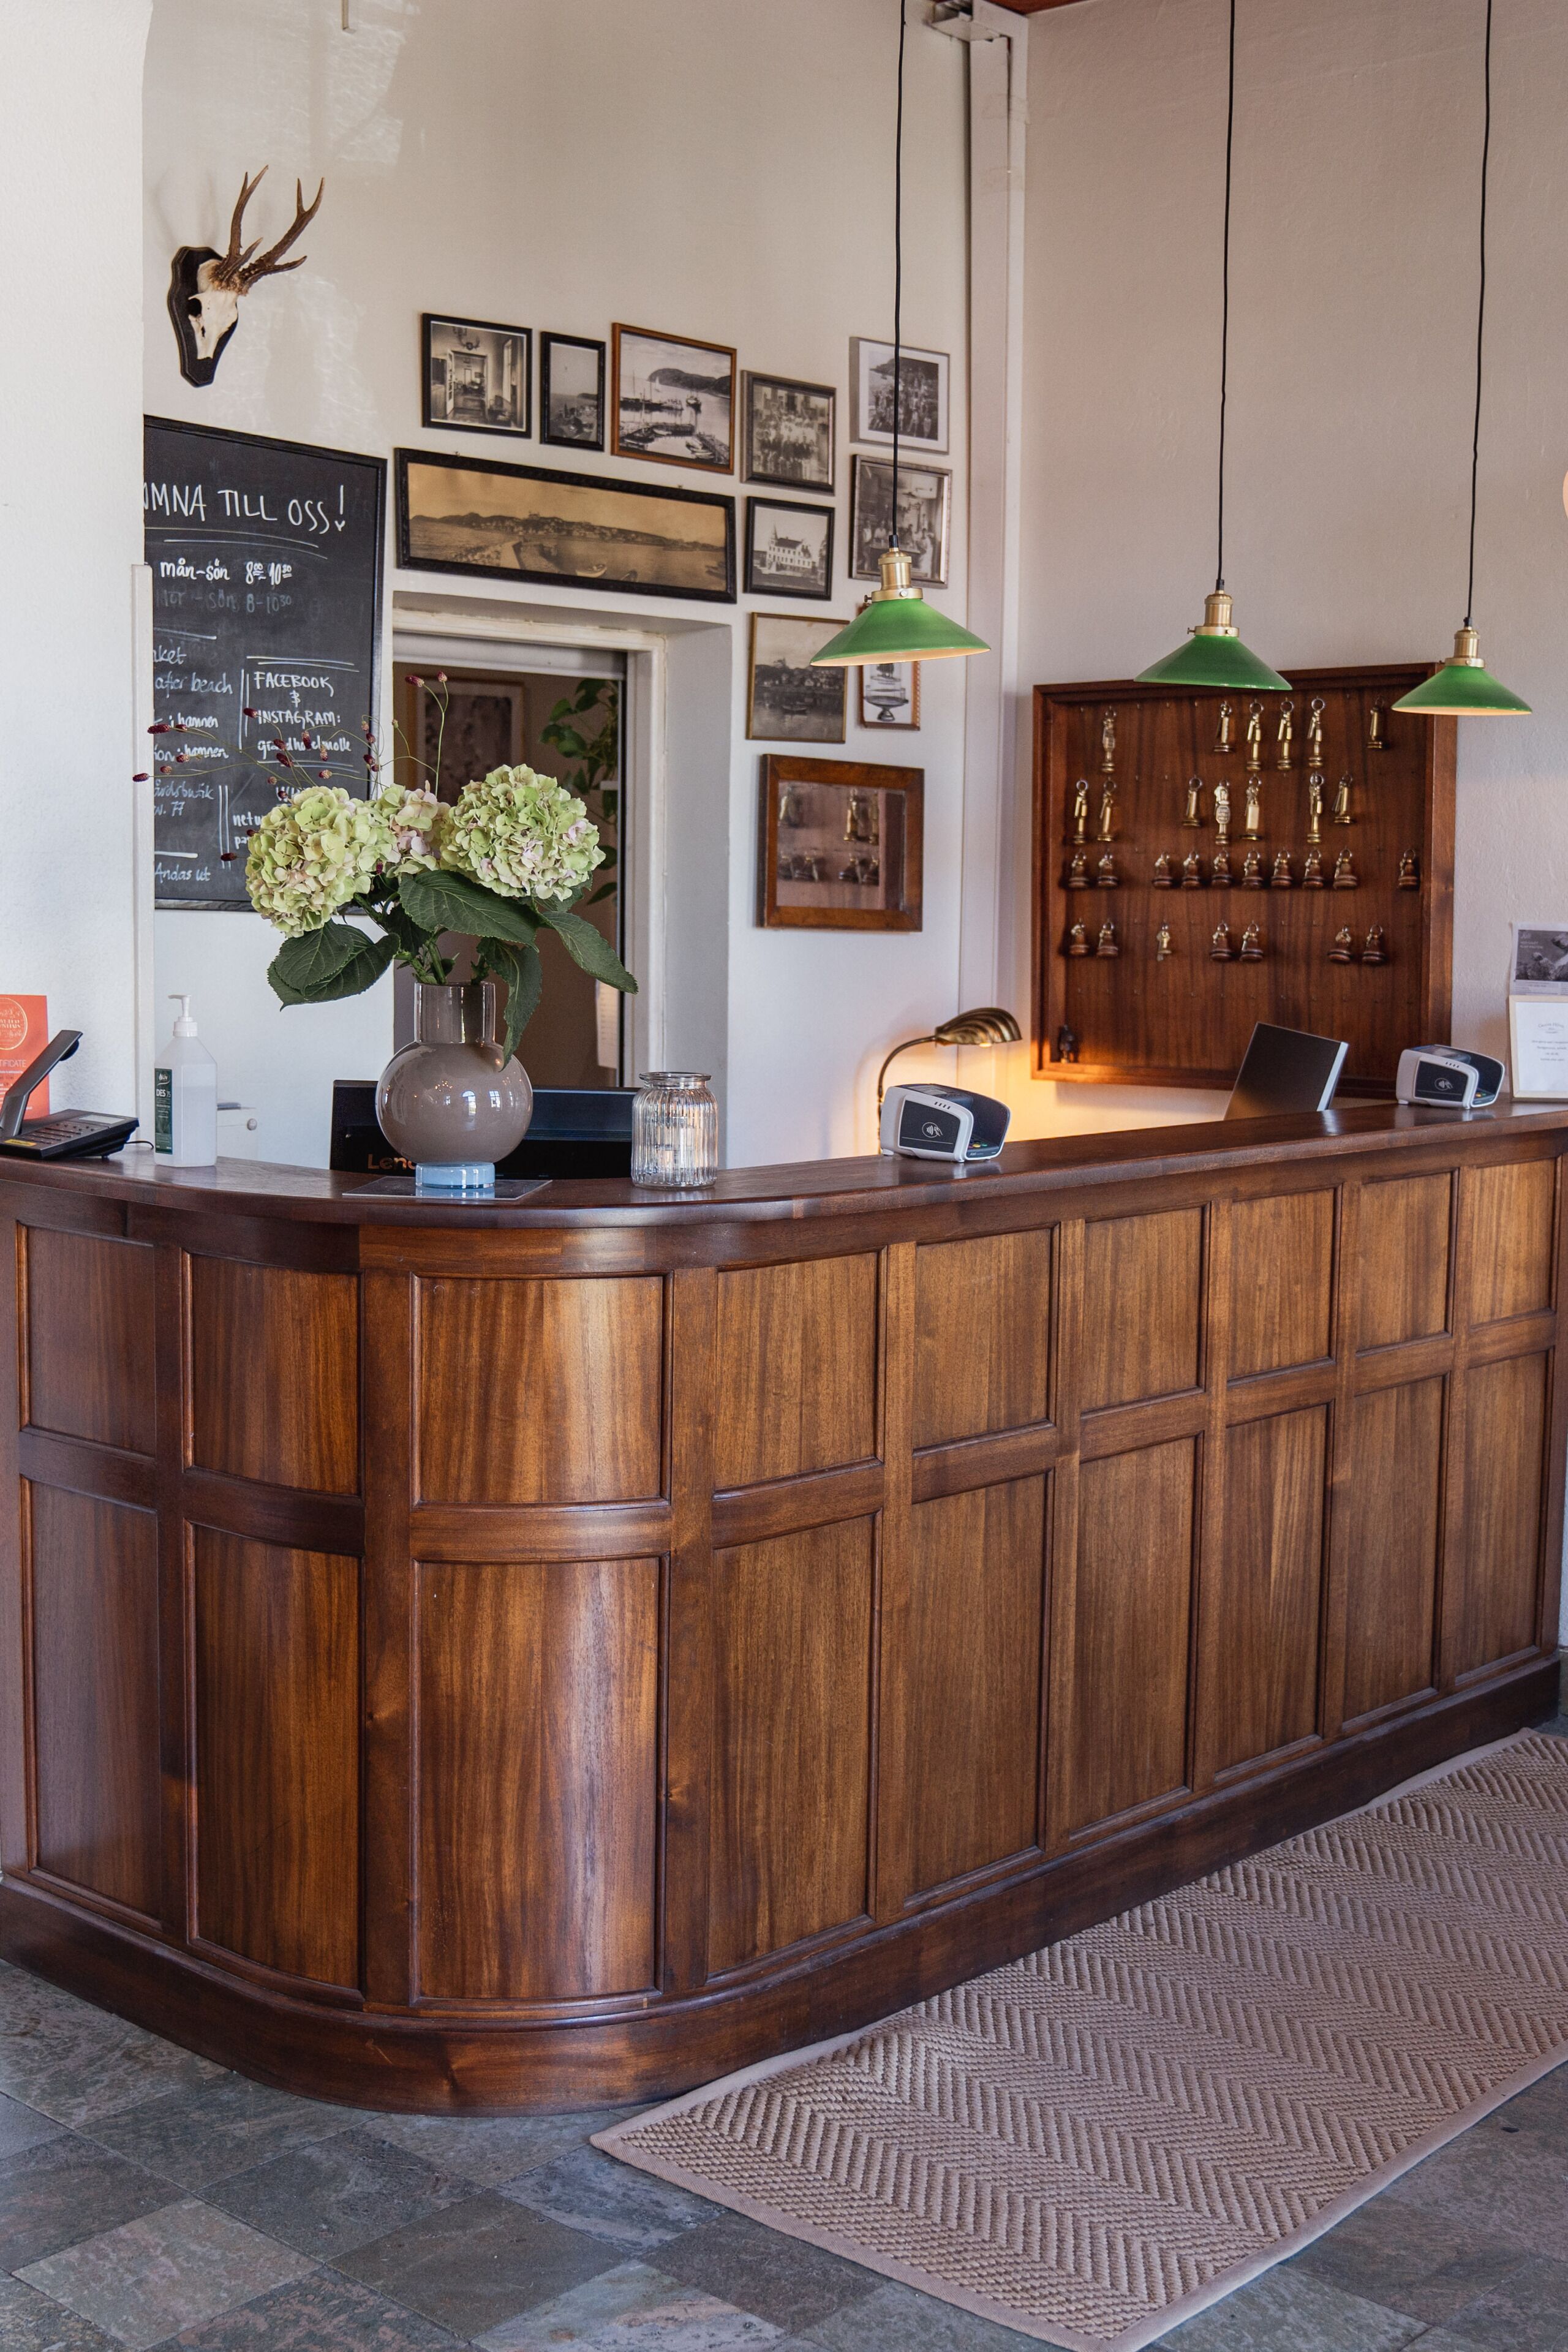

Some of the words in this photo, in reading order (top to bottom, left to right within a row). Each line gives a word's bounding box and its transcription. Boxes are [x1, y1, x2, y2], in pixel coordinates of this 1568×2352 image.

[217, 489, 278, 521] TILL
[288, 484, 346, 535] OSS!
[191, 672, 233, 695] beach
[254, 671, 334, 697] FACEBOOK
[257, 710, 341, 729] INSTAGRAM:
[154, 862, 192, 883] Andas
[196, 867, 211, 881] ut
